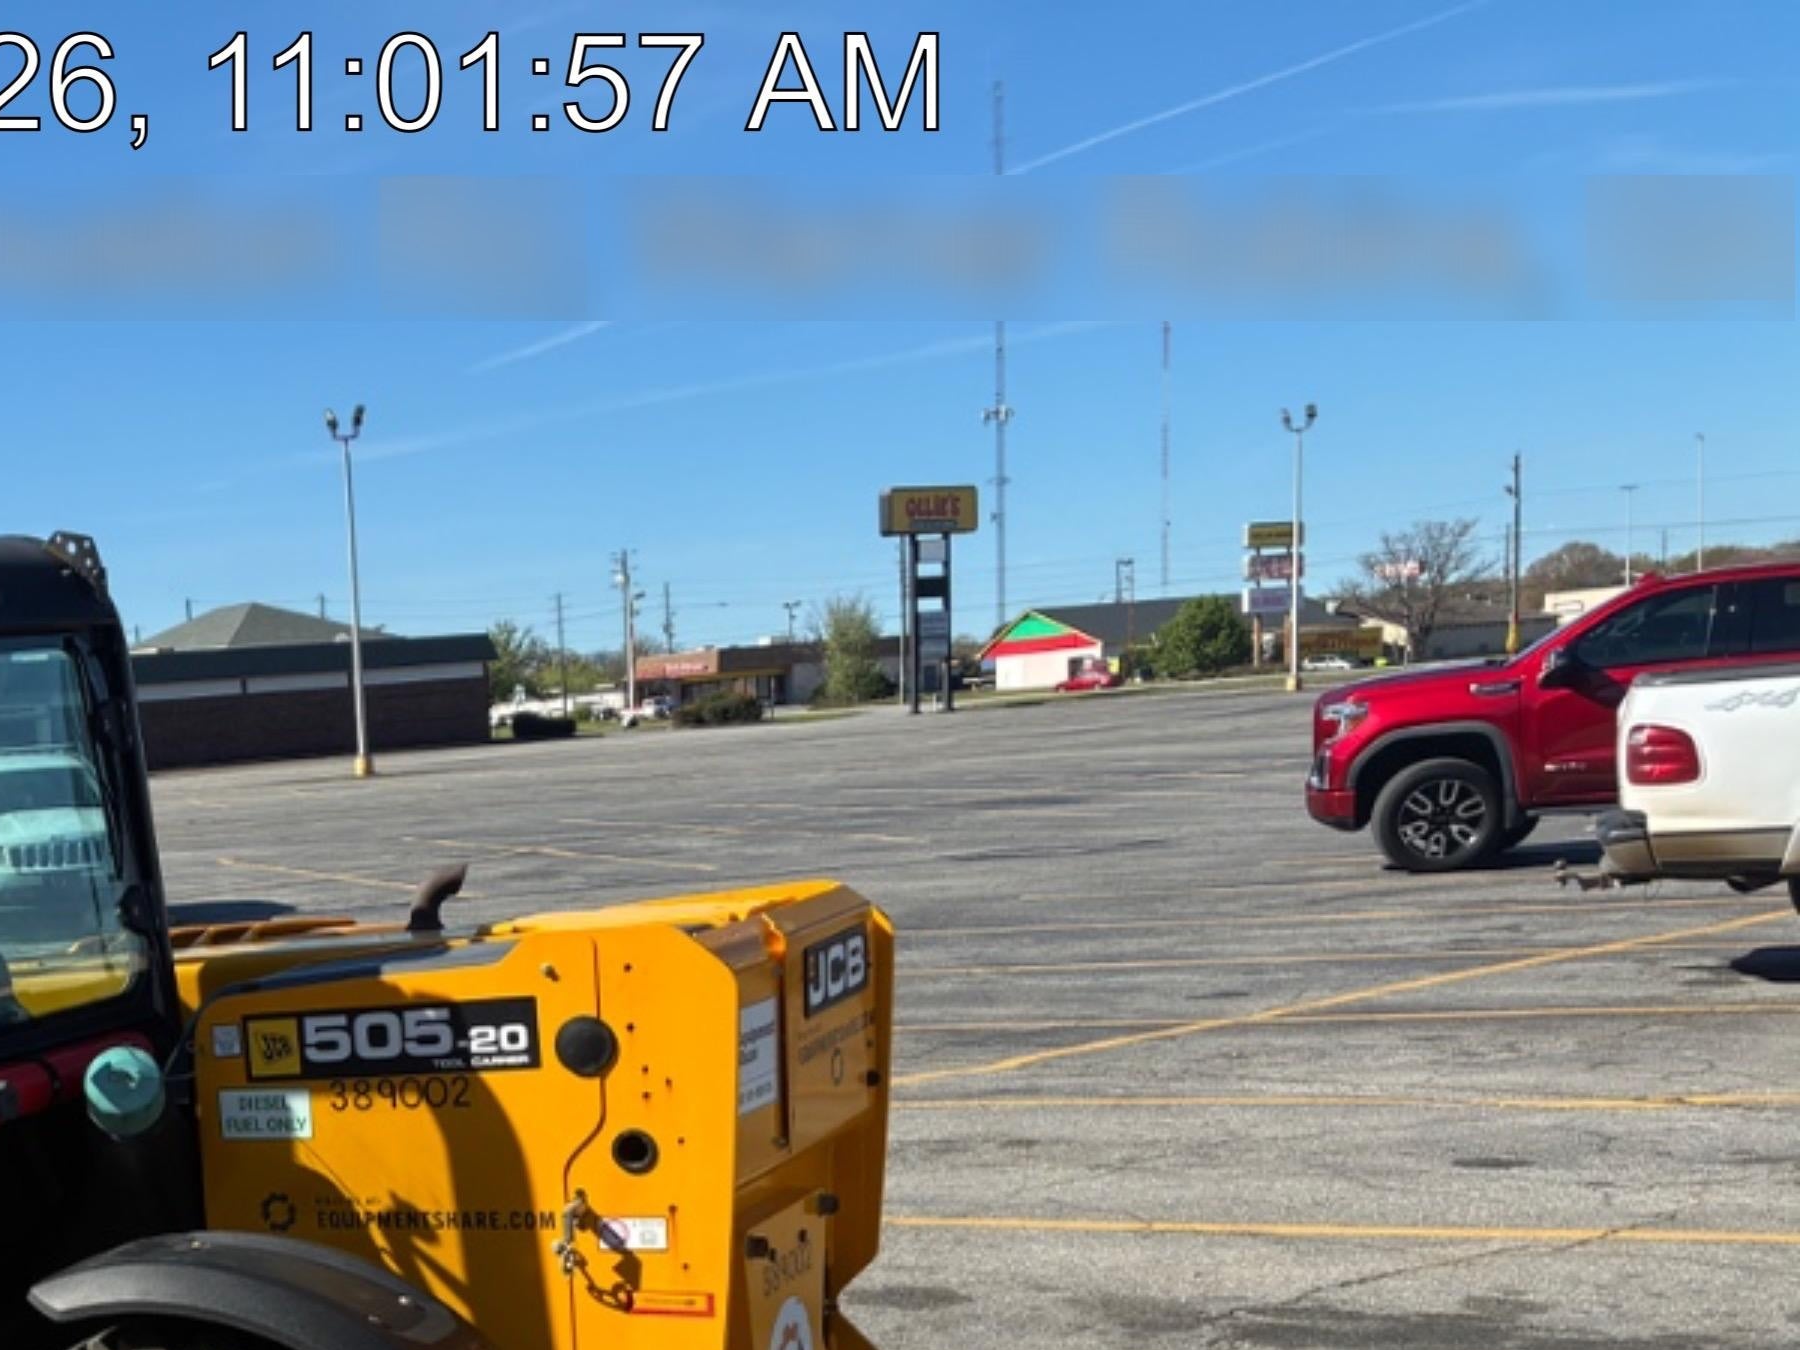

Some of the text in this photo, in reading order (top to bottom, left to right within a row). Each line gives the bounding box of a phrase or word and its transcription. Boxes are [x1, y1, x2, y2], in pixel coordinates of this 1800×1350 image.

[809, 935, 866, 1006] JCB
[239, 1094, 291, 1111] DIESEL
[330, 1077, 471, 1112] 389002
[225, 1114, 307, 1132] FUEL ONLY
[316, 1210, 556, 1231] EQUIPMENTSHARE.COM
